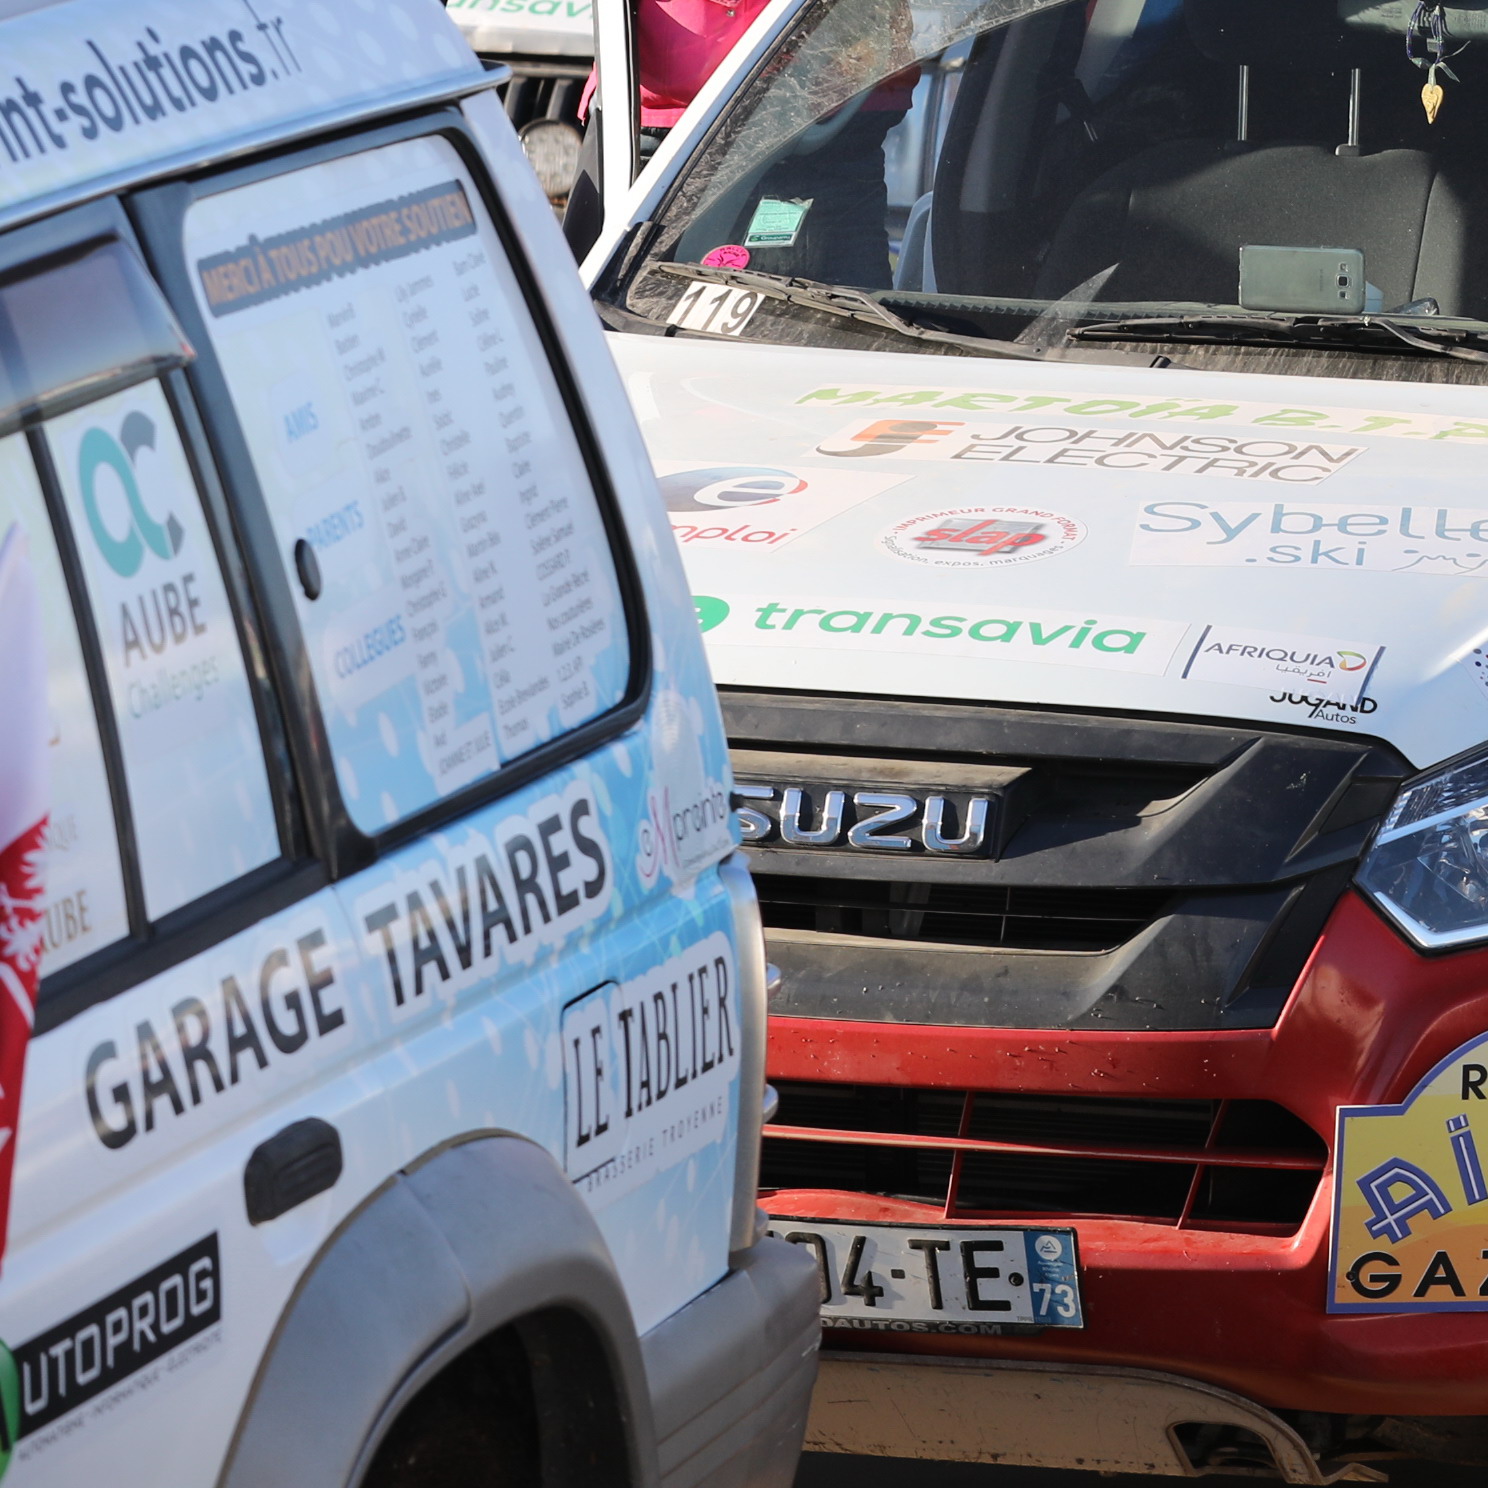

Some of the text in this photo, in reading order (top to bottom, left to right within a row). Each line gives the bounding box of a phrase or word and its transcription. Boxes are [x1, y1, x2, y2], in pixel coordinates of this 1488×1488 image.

[678, 286, 758, 334] 119
[950, 443, 1333, 483] ELECTRIC
[969, 424, 1364, 466] JOHNSON
[668, 522, 798, 547] mploi
[894, 507, 1080, 541] IMPRIMEUR GRAND FORMAT
[912, 519, 1048, 557] slap
[1244, 539, 1367, 567] .ski
[120, 572, 208, 669] AUBE
[754, 600, 1148, 656] transavia
[1204, 643, 1336, 669] AFRIQUIA
[1315, 709, 1357, 725] Autos
[734, 787, 994, 856] SUZU
[84, 795, 608, 1152] GARAGE TAVARES
[573, 956, 734, 1148] LE TABLIER
[662, 1096, 724, 1148] TROYENNE
[1032, 1283, 1077, 1319] 73
